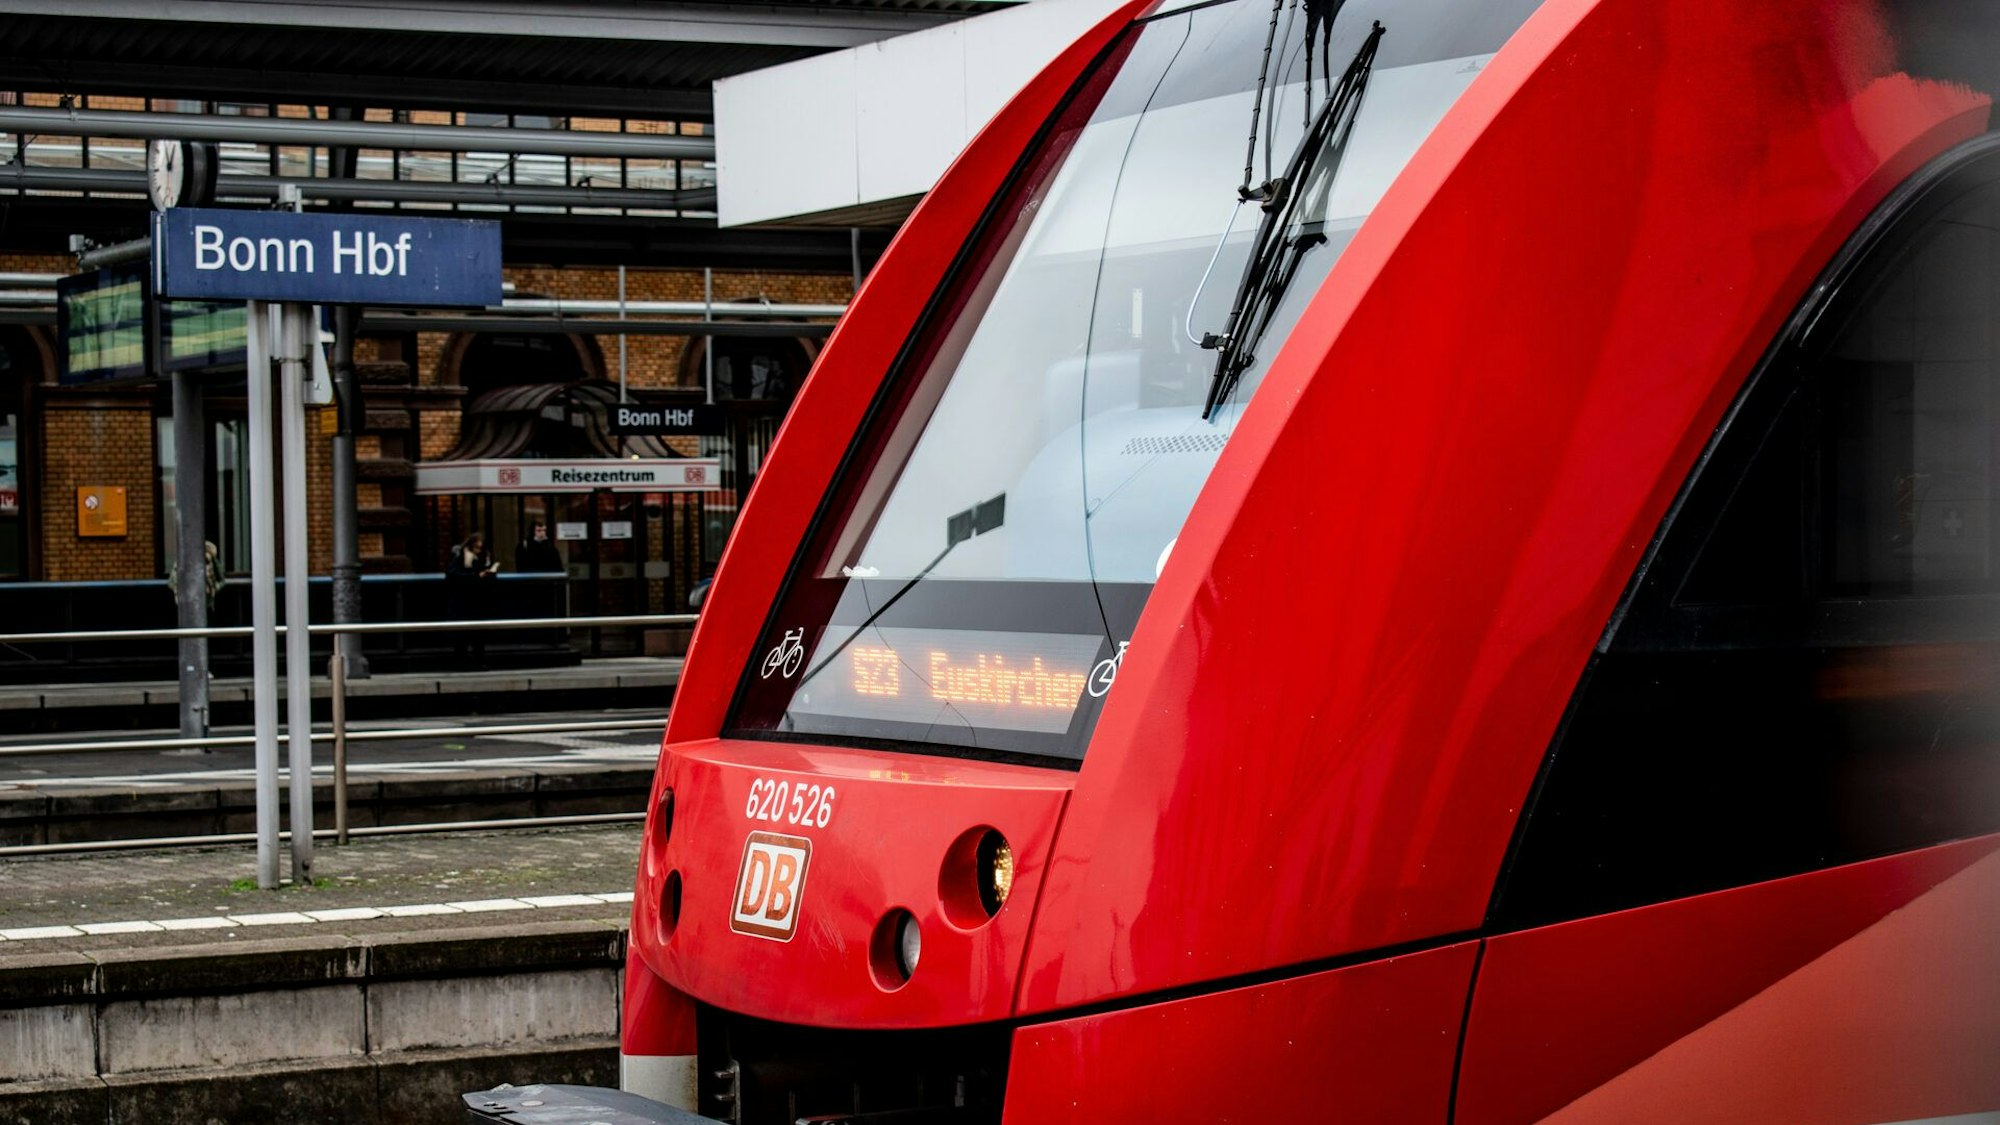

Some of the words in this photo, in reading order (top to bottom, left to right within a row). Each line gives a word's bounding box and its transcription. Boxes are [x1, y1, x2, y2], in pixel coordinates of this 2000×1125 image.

[195, 225, 315, 274] Bonn
[333, 230, 412, 277] Hbf
[618, 408, 661, 427] Bonn
[665, 408, 694, 427] Hbf
[500, 470, 519, 484] DB
[551, 469, 655, 484] Reisezentrum
[686, 469, 704, 482] DB
[853, 648, 899, 696] S23
[746, 778, 788, 822] 620
[788, 783, 835, 828] 526
[740, 849, 797, 922] DB
